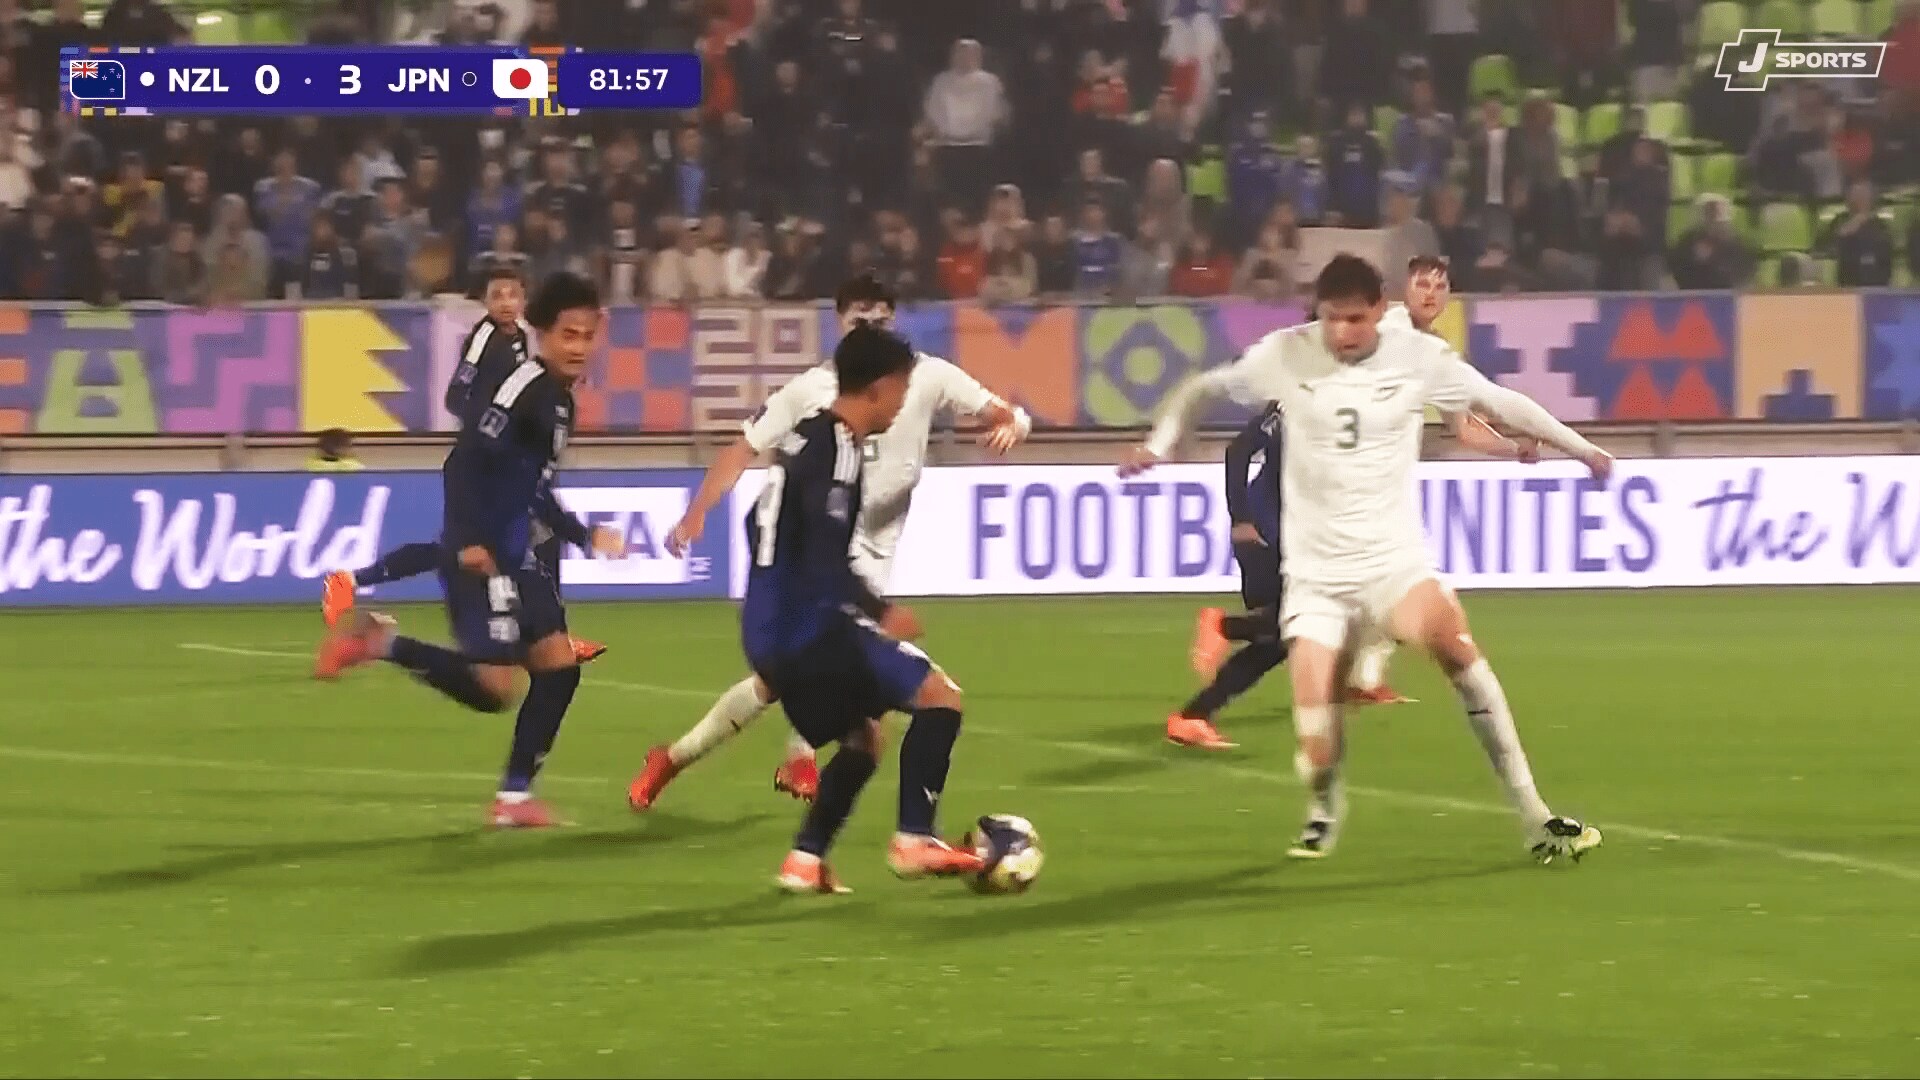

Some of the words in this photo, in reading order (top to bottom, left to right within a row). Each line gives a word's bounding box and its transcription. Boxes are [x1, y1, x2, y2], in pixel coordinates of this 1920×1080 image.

[1336, 407, 1360, 450] 3
[0, 484, 123, 593] the
[131, 478, 391, 590] World
[970, 482, 1236, 580] FOOTB
[1690, 466, 1826, 571] the
